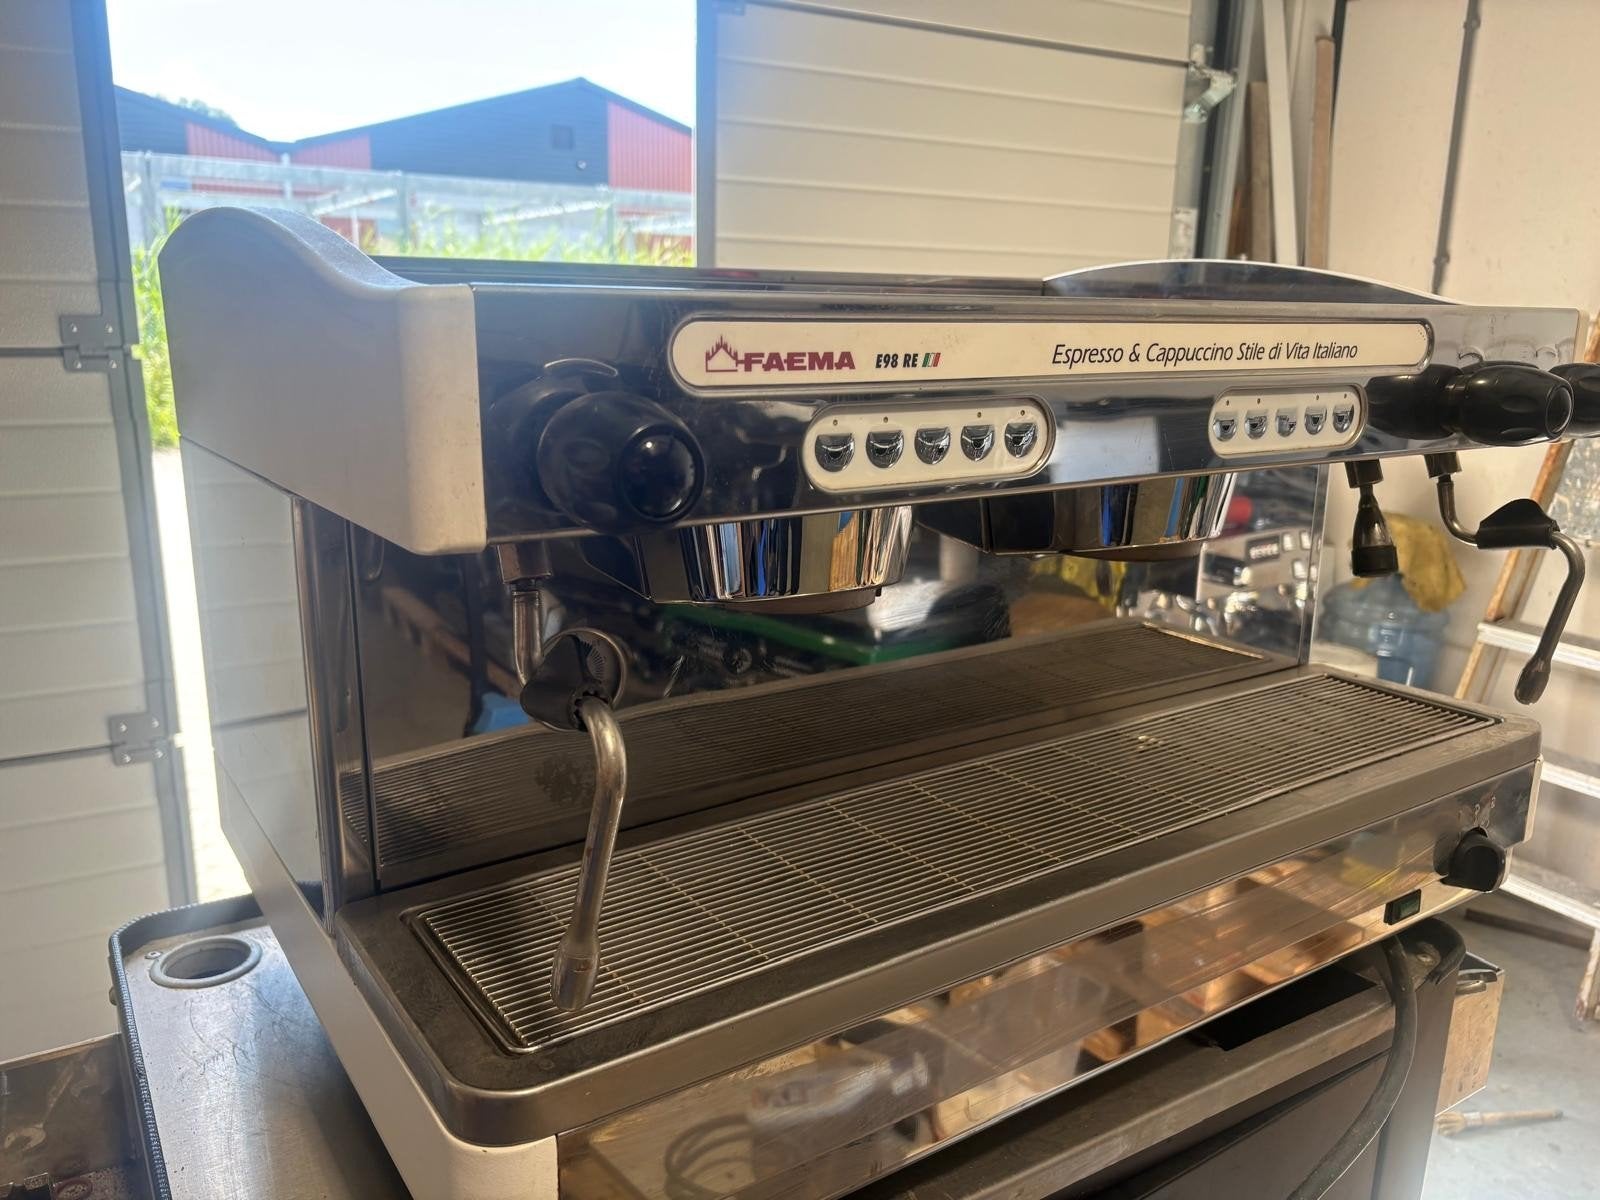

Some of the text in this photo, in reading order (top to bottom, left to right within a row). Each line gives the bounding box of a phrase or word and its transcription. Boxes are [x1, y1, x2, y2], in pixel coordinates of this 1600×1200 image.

[744, 351, 919, 372] FAEMA E98 RE
[1052, 342, 1358, 370] Espresso & Cappuccino Stile di Vita Italiano
